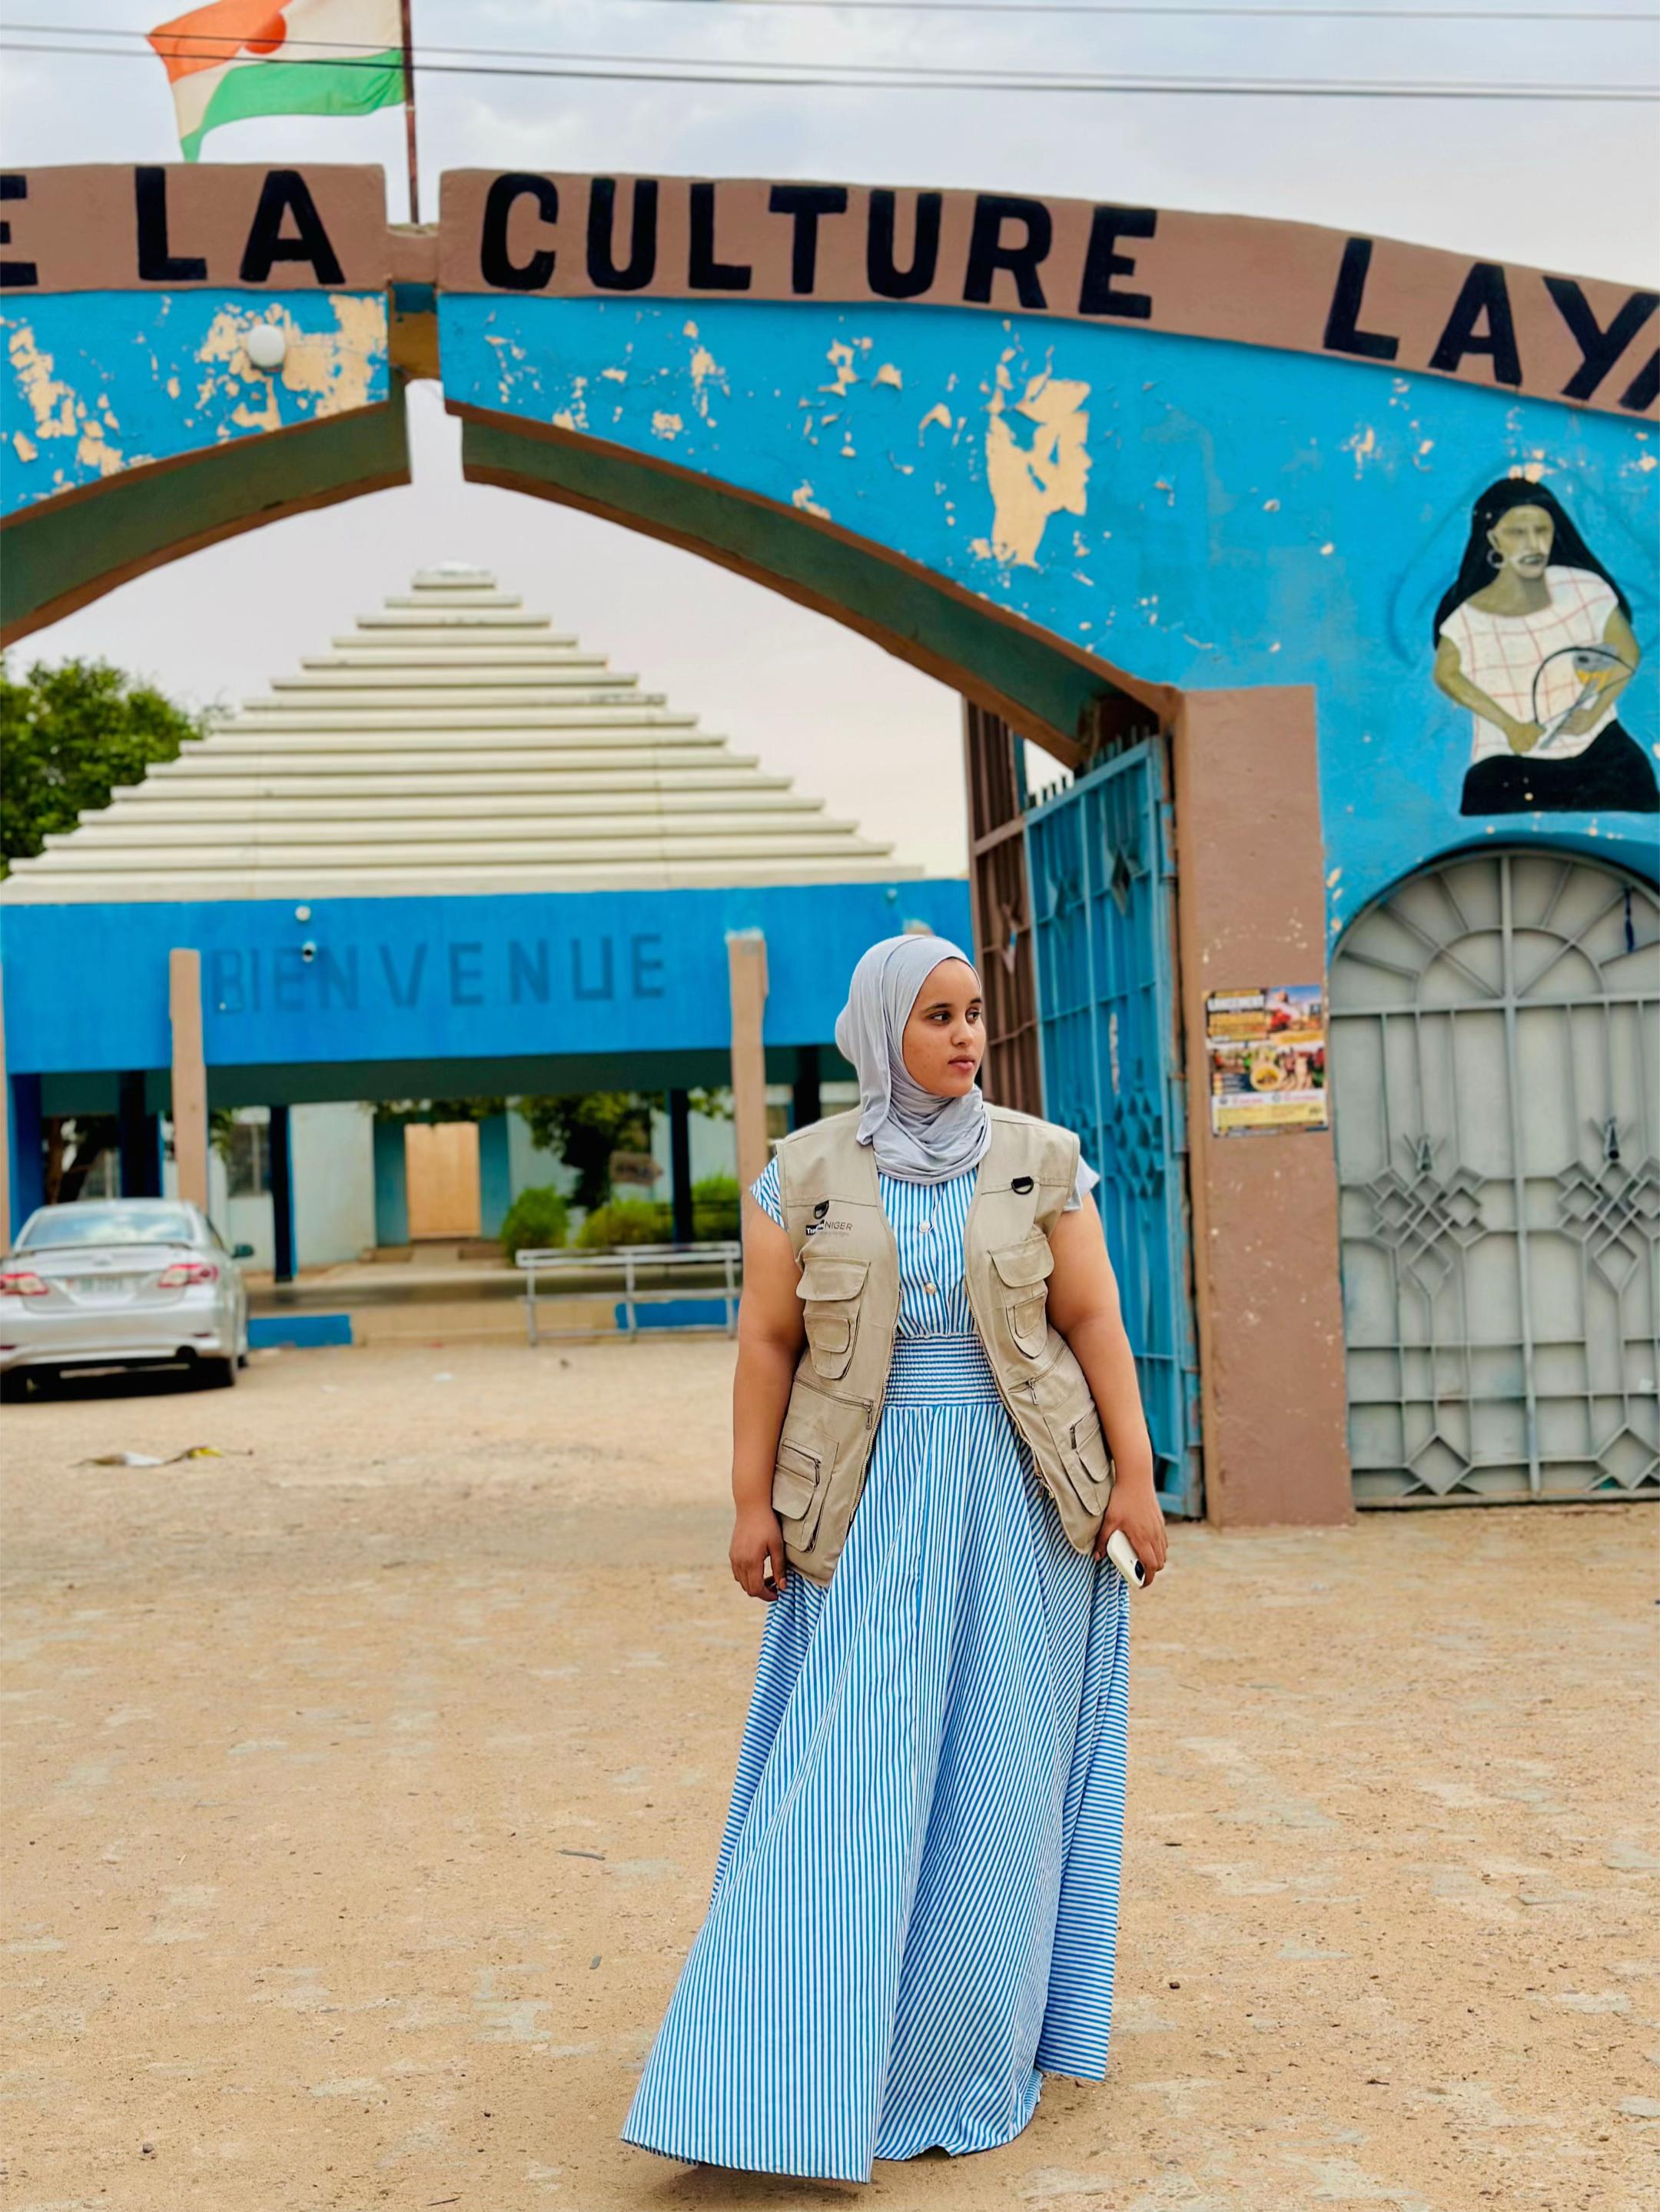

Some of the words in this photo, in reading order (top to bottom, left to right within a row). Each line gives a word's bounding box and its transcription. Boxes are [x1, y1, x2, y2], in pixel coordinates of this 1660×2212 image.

[134, 165, 346, 285] LA
[480, 171, 1157, 319] CULTURE
[211, 932, 664, 1015] BIENVENUE
[825, 1221, 852, 1231] NIGER
